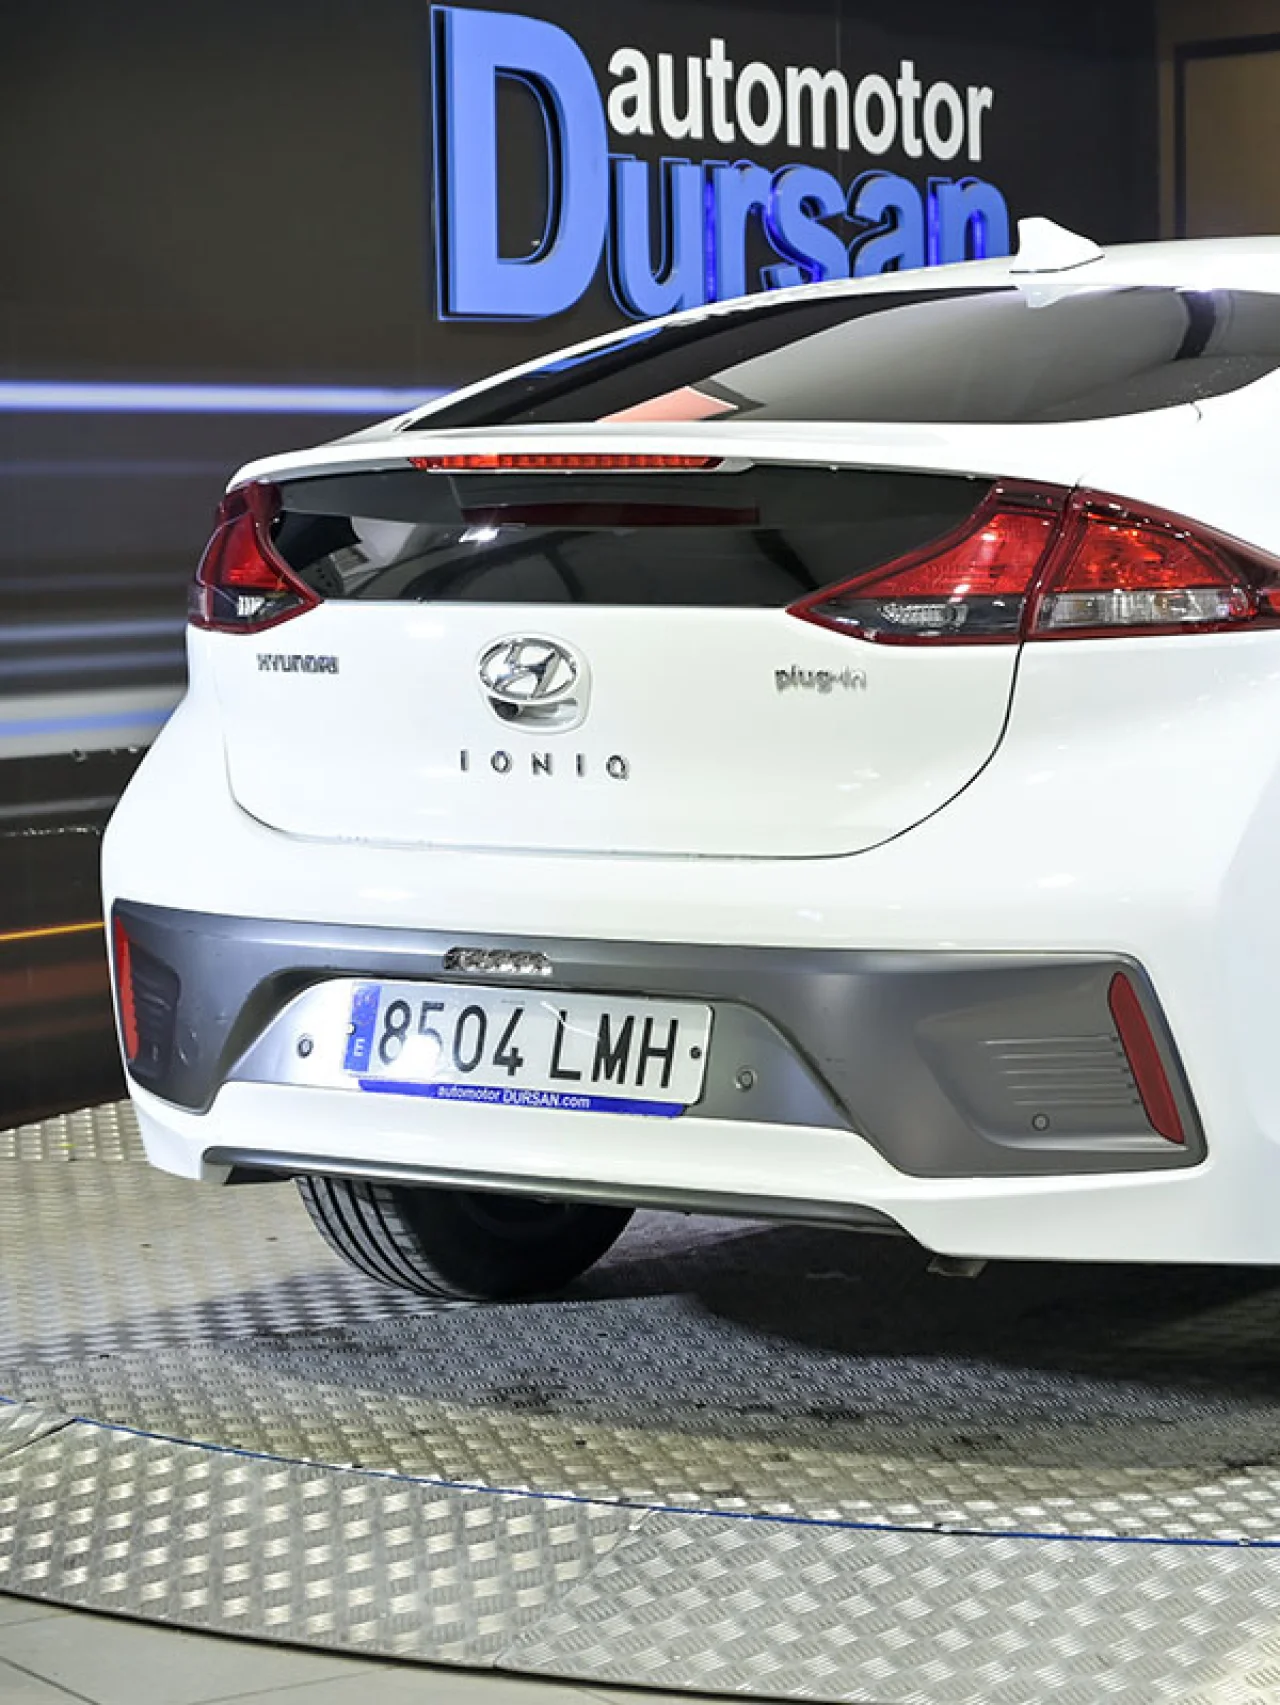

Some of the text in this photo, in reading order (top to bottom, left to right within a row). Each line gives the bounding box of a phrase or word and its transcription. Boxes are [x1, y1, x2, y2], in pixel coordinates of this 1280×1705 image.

[607, 38, 993, 161] automotor
[431, 4, 1010, 321] Dursan
[256, 653, 340, 674] HYUNDAI
[459, 749, 631, 780] IONIQ
[353, 1038, 365, 1057] E
[379, 999, 679, 1088] 8504 LMH
[437, 1085, 591, 1109] automotor DURSAN.com
